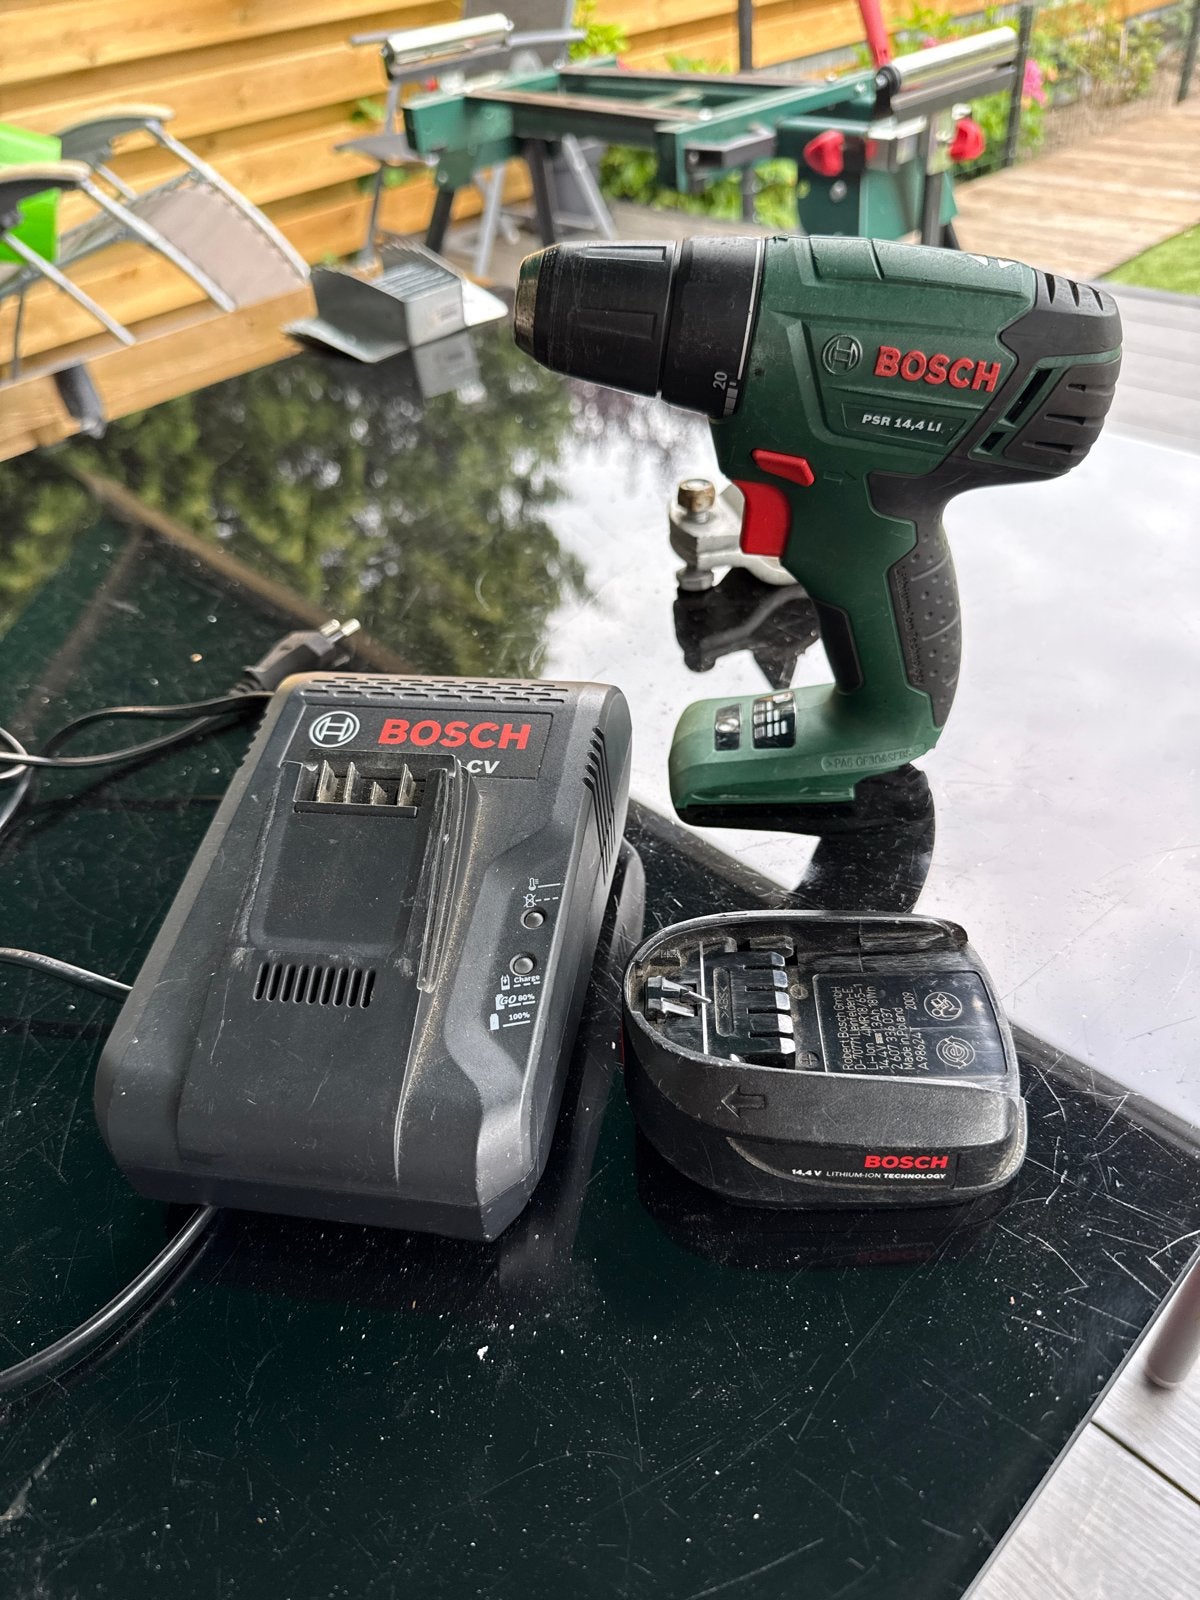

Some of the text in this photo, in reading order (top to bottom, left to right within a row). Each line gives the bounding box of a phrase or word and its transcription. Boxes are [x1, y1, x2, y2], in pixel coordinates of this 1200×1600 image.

[874, 345, 1001, 393] BOSCH
[712, 371, 728, 391] 20
[861, 414, 942, 431] PSR 14,4 LI
[377, 718, 532, 750] BOSCH
[514, 975, 541, 984] Charge
[518, 994, 536, 1002] 80%
[902, 991, 917, 1010] 2009
[509, 1012, 531, 1021] 100%
[880, 1007, 894, 1024] 037
[830, 986, 854, 1070] Robert Bosch GmbH
[892, 1007, 915, 1070] Made in Poland
[851, 1036, 867, 1070] D-70771
[865, 1042, 879, 1070] Li-Ion
[887, 1044, 901, 1062] 607
[864, 1155, 949, 1168] BOSCH
